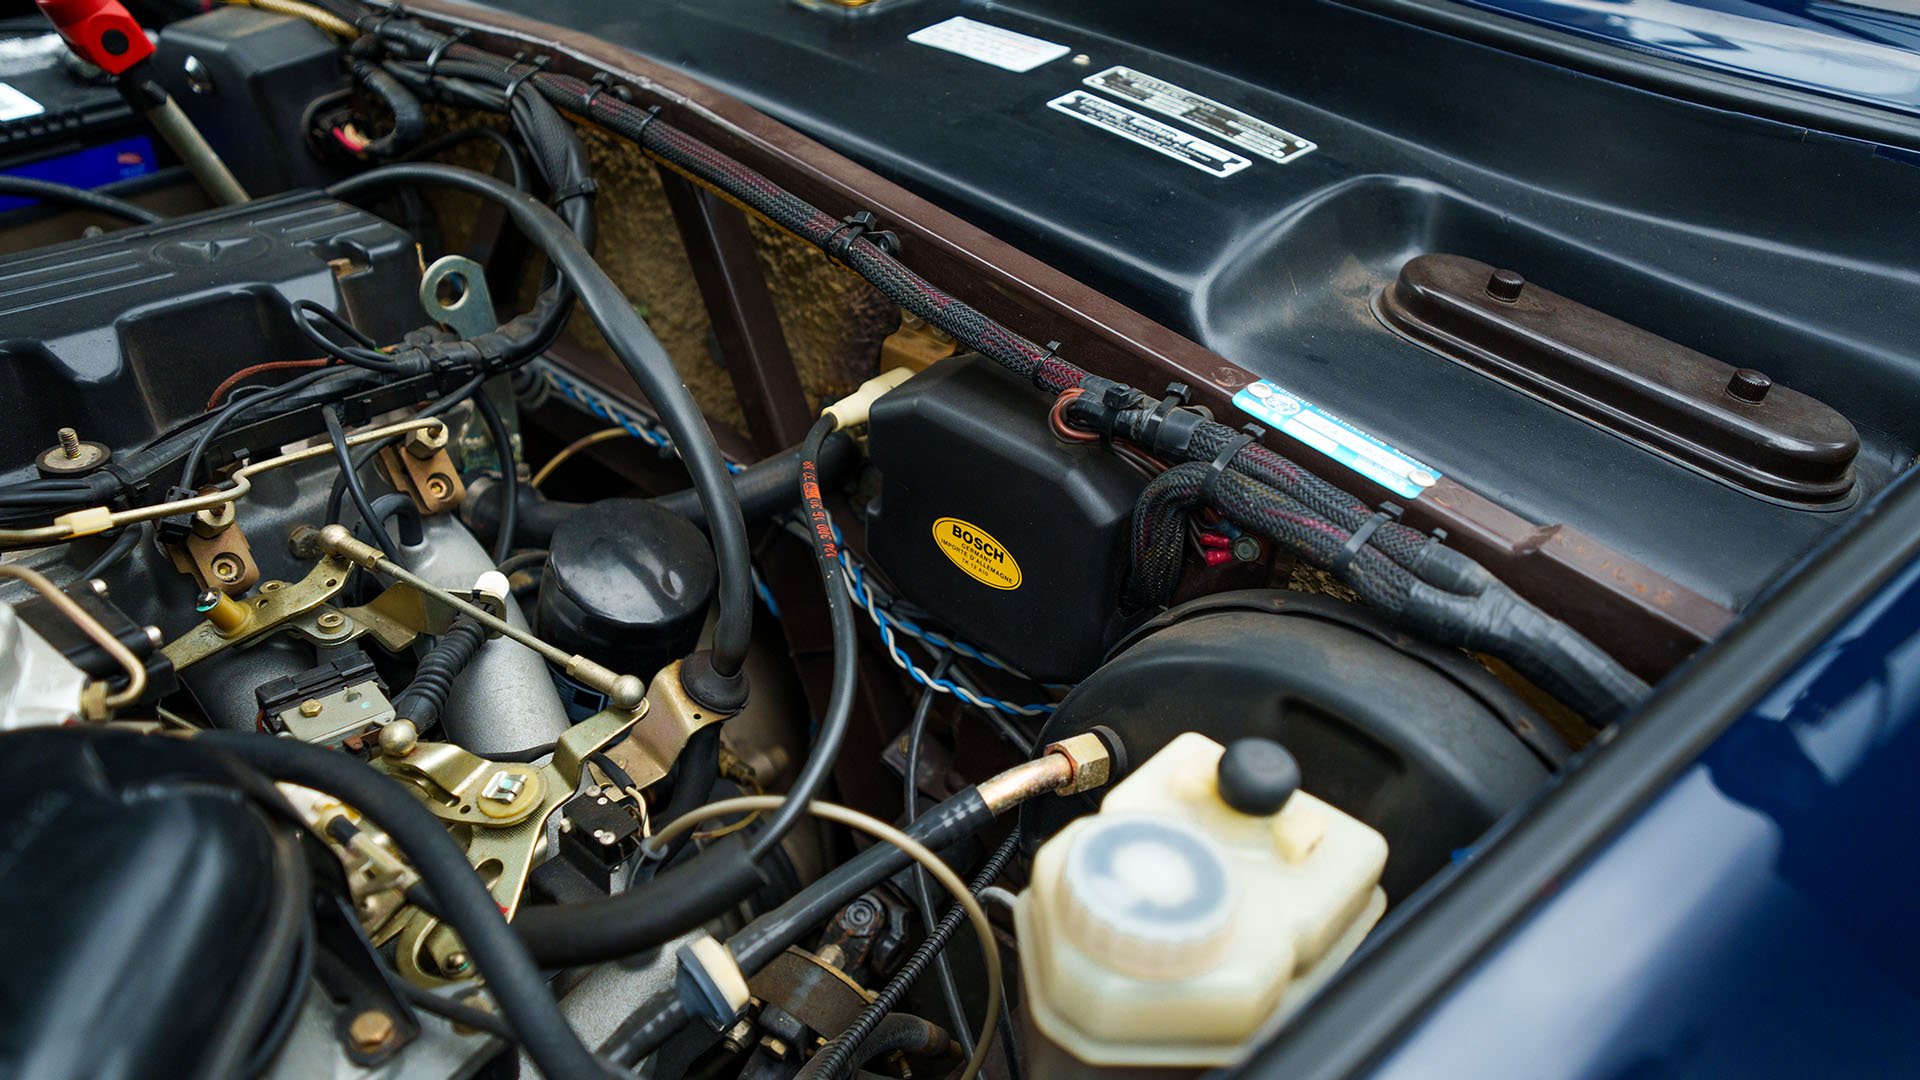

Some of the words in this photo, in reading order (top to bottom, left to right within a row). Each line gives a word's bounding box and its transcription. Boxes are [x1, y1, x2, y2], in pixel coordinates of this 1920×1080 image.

[1268, 382, 1313, 408] ASSIGNED
[1317, 408, 1388, 447] IDENTIFICATION
[1393, 448, 1434, 471] NUMBER
[941, 538, 967, 557] IMPORTE
[952, 524, 1004, 563] BOSCH
[961, 543, 993, 564] GERMANY
